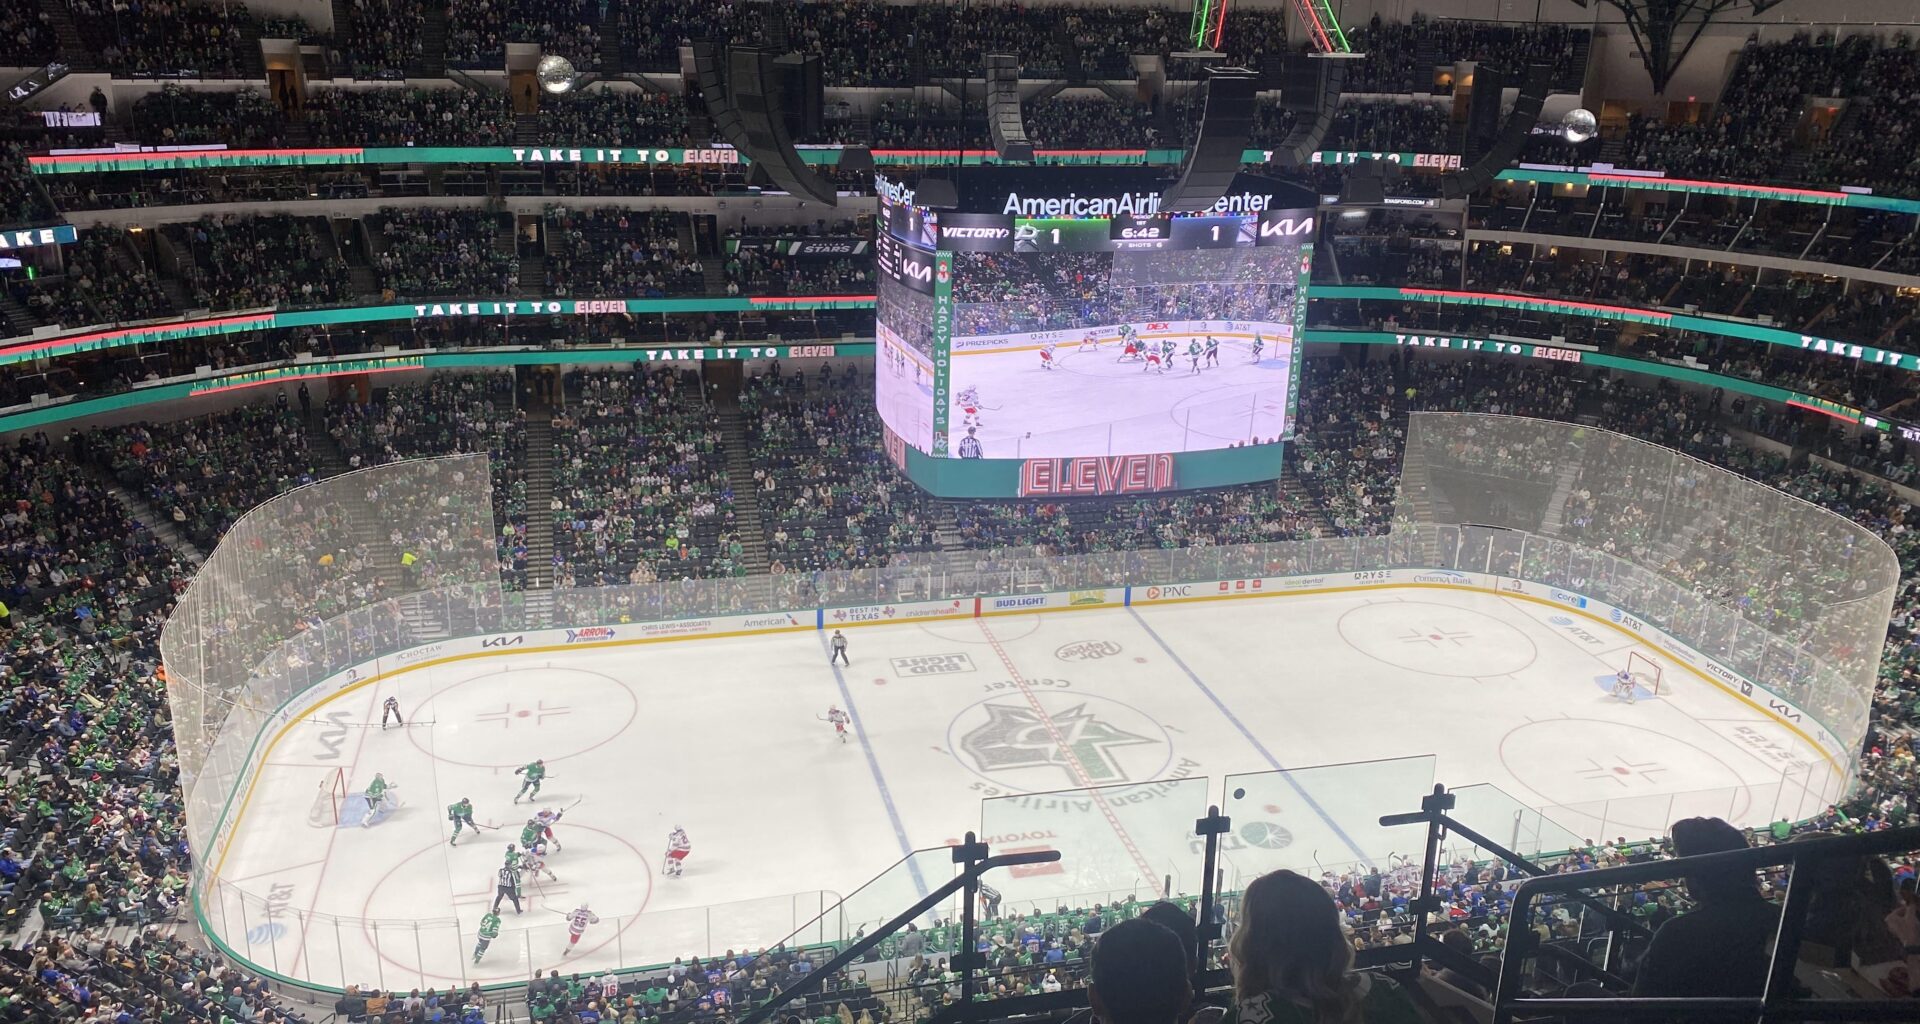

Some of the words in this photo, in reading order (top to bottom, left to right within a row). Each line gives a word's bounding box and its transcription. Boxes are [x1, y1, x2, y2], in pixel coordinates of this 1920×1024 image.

[512, 149, 582, 162] TAKE
[597, 149, 622, 161] IT
[637, 149, 669, 162] TO
[1336, 152, 1358, 163] IT
[942, 227, 1004, 239] VICTORY
[1051, 228, 1060, 244] 1
[1121, 227, 1160, 238] 6:42
[1211, 225, 1219, 242] 1
[803, 245, 851, 253] STARS
[414, 304, 480, 316] TAKE
[493, 302, 517, 314] IT
[531, 302, 562, 313] TO
[1295, 286, 1307, 332] HAPPY
[937, 295, 948, 344] HAPPY
[965, 338, 1009, 347] PRIZEPICKS
[1396, 334, 1450, 348] TAKE
[1462, 339, 1483, 350] IT
[1496, 342, 1522, 354] TO
[646, 349, 704, 361] TAKE
[717, 348, 738, 359] IT
[750, 347, 778, 358] TO
[1801, 335, 1863, 358] TAKE
[1876, 350, 1902, 365] IT
[1287, 338, 1301, 409] HOLIDAYS
[935, 349, 947, 425] HOLIDAYS
[1163, 585, 1191, 597] PNC
[996, 598, 1016, 608] BUD
[1017, 596, 1045, 606] LIGHT
[743, 617, 786, 628] American
[850, 612, 880, 621] TEXAS
[1622, 615, 1643, 633] AT&T
[578, 627, 608, 637] ARROW
[897, 654, 967, 669] LIGHT
[910, 662, 962, 674] BUD
[1706, 661, 1740, 684] VICTORY
[983, 678, 1071, 693] Center
[1111, 757, 1199, 808] American
[968, 780, 1092, 814] Airlines
[982, 829, 1057, 845] TOYOTA
[574, 916, 587, 928] 55
[605, 984, 617, 997] 16
